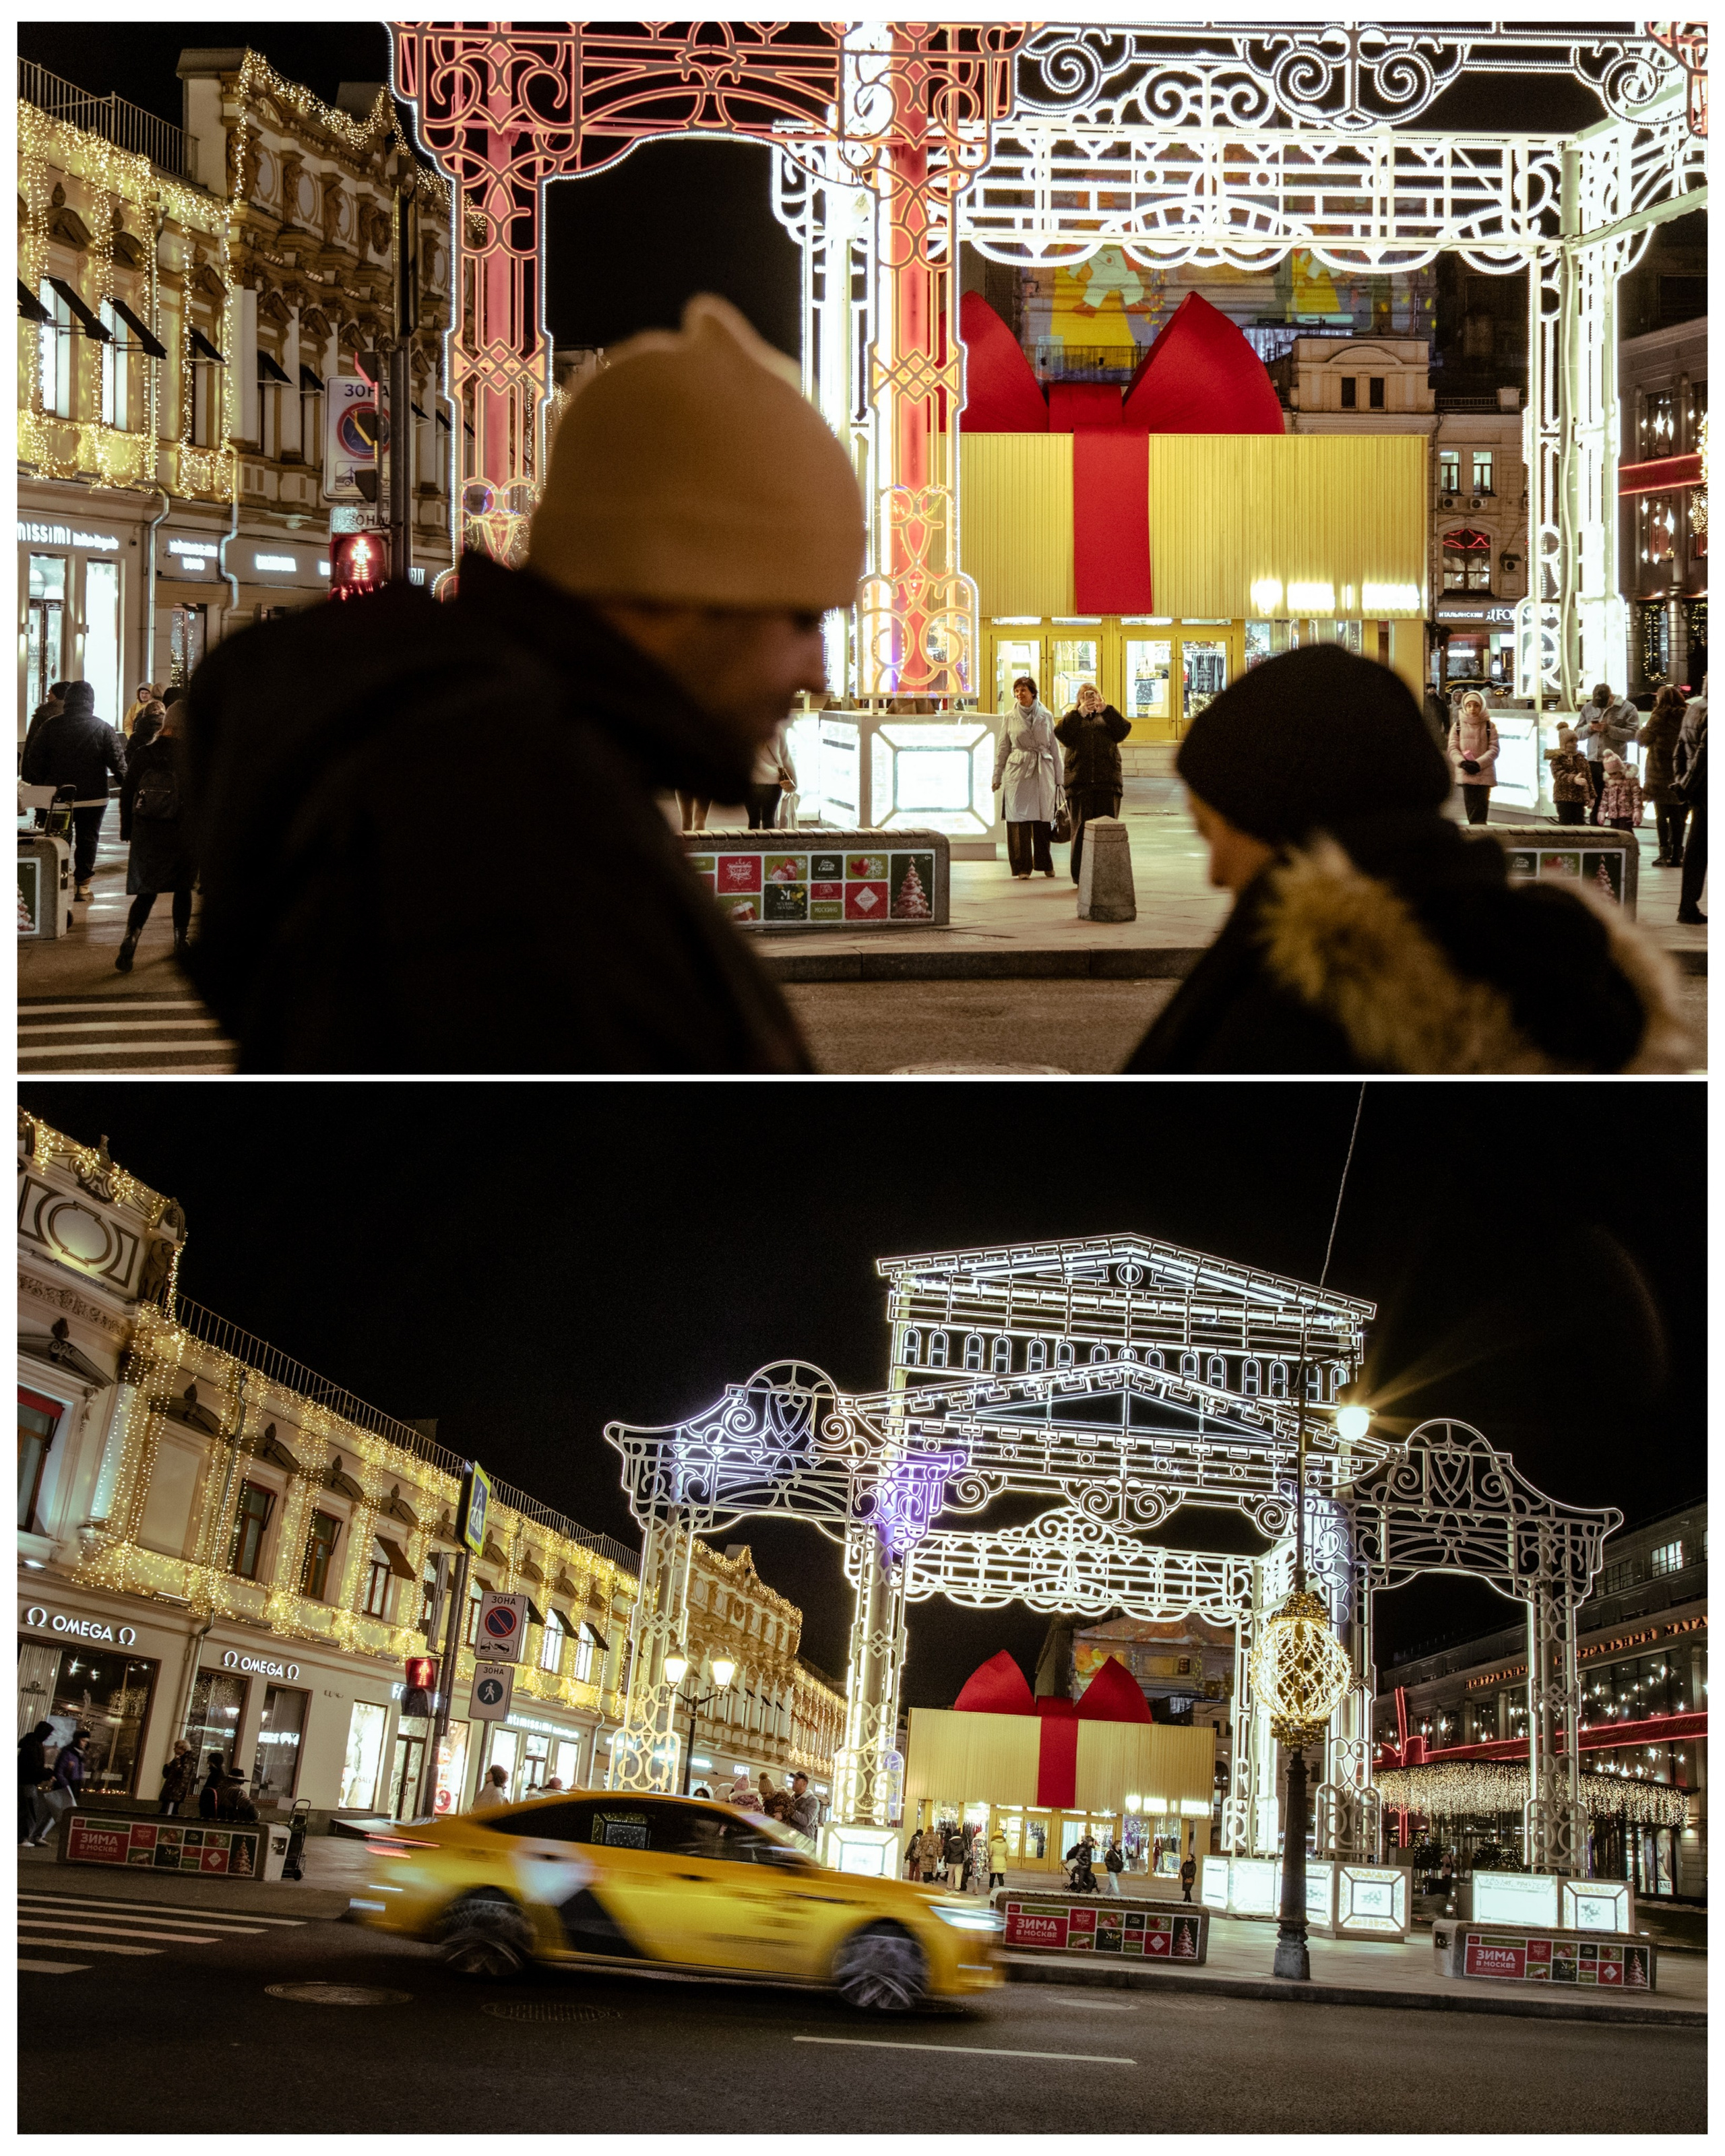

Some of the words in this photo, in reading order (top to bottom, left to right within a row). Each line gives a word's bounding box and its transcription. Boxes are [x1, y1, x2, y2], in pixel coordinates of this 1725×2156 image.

[492, 1595, 515, 1605] ЗОНА
[52, 1616, 113, 1642] OMEGA
[241, 1657, 283, 1678] OMEGA
[483, 1667, 504, 1675] ЗОНА
[80, 1833, 119, 1847] ЗИМА
[86, 1845, 118, 1853] МОСКВЕ
[1017, 1918, 1057, 1931] ЗИМА
[1476, 1949, 1516, 1962] ЗИМА
